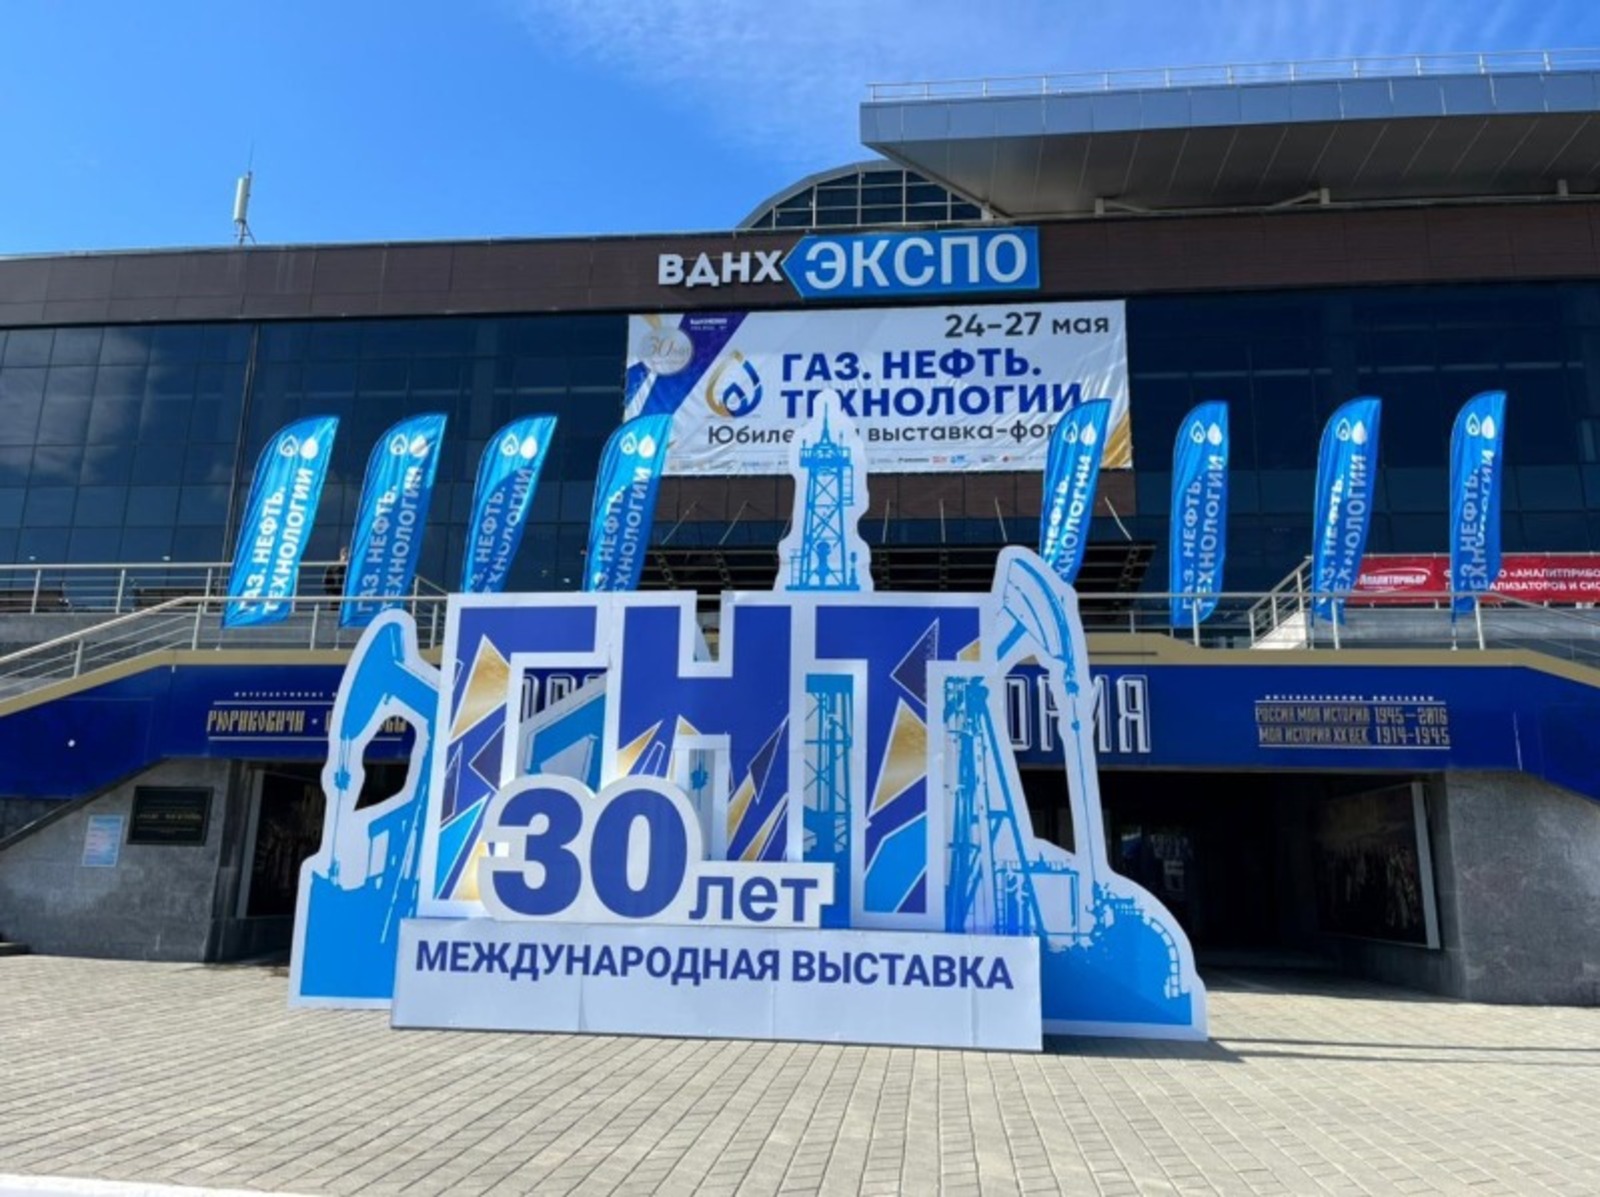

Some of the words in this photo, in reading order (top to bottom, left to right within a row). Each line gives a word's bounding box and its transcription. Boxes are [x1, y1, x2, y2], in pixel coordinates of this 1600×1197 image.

[657, 249, 784, 288] ВДНХ
[804, 233, 1028, 290] ЭКСПО
[782, 351, 871, 382] ГАЗ.
[881, 347, 1042, 380] НЕФТЬ.
[1052, 316, 1109, 335] мая
[252, 485, 286, 565] НЕФТЬ.
[263, 467, 314, 615] ТЕХНОЛОГИИ
[369, 485, 398, 564] НЕФТЬ.
[475, 486, 506, 563] НЕФТЬ.
[598, 485, 626, 563] НЕФТЬ.
[1182, 474, 1202, 557] НЕФТЬ.
[1196, 454, 1223, 612] ТЕХНОЛОГИИ
[1324, 474, 1344, 556] НЕФТЬ.
[1460, 468, 1479, 552] НЕФТЬ.
[491, 785, 690, 921] 30
[688, 875, 819, 923] лет
[415, 939, 781, 987] МЕЖДУНАРОДНАЯ
[790, 950, 1015, 990] ВЫСТАВКА
